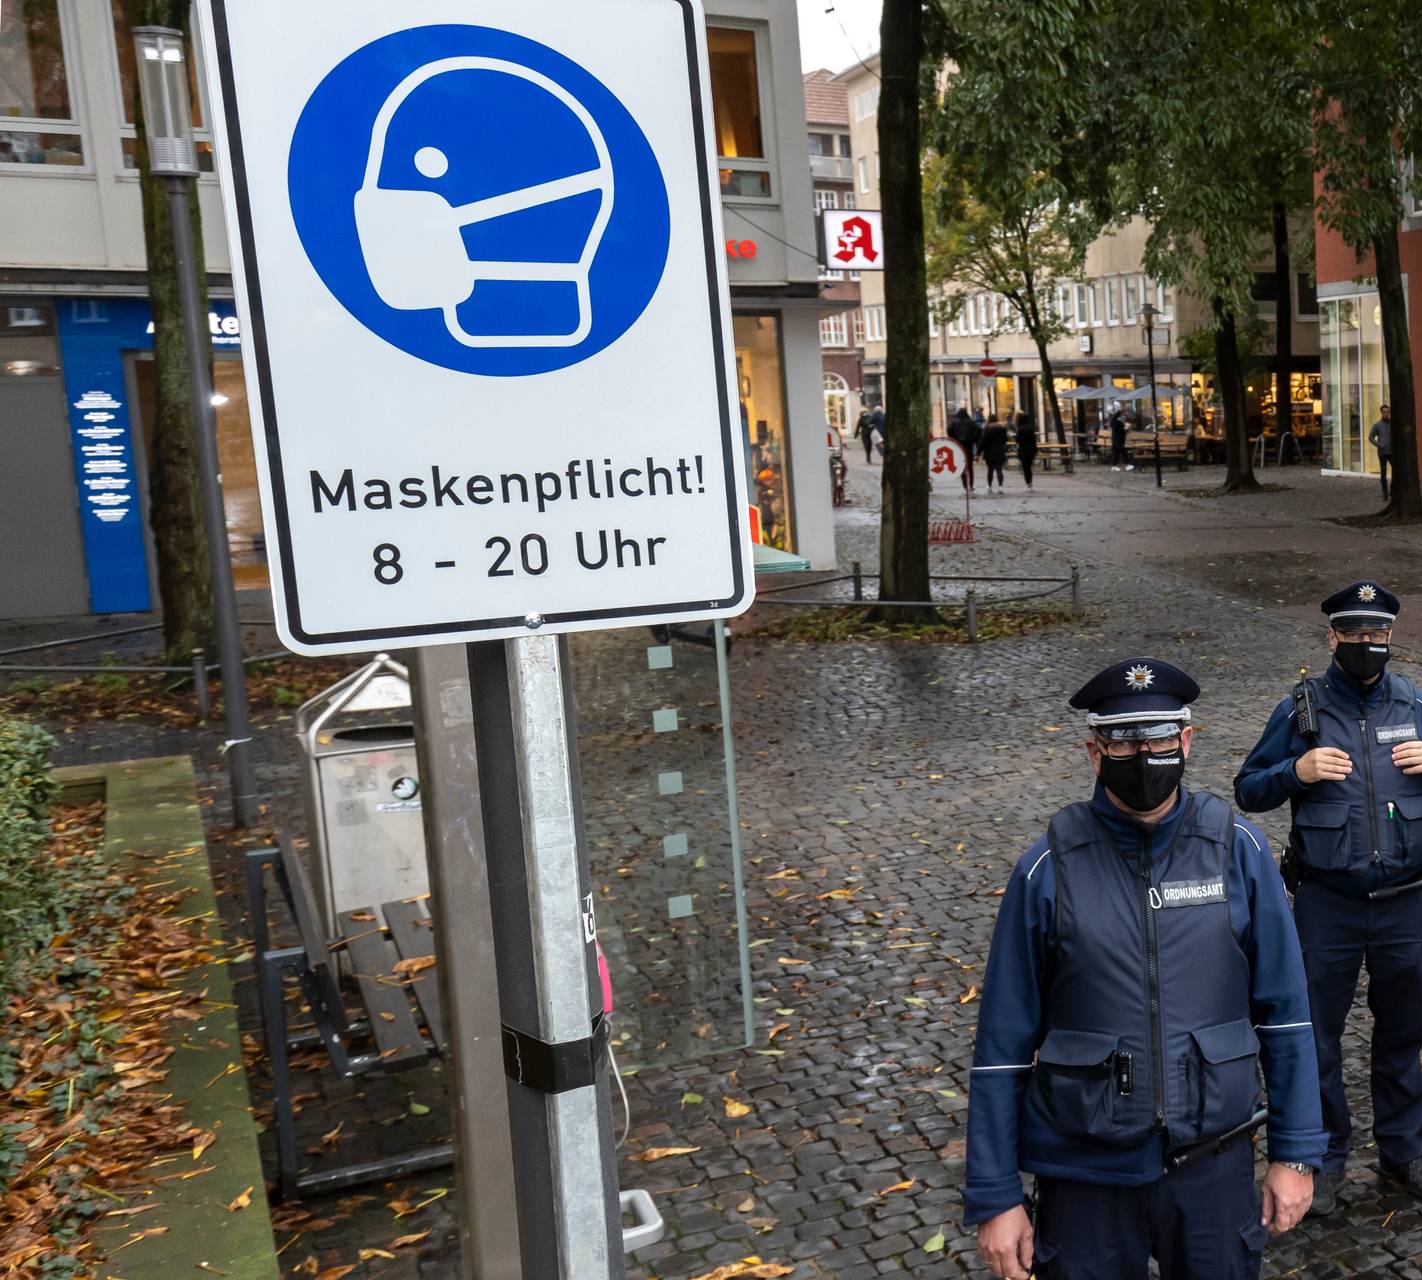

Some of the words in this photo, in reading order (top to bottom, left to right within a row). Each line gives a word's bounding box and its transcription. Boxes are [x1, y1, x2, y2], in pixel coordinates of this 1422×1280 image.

[309, 455, 705, 513] Maskenpflicht!
[373, 543, 404, 585] 8
[435, 560, 456, 569] -
[485, 533, 548, 577] 20
[575, 528, 667, 570] Uhr
[1164, 882, 1224, 901] ORDNUNGSAMT
